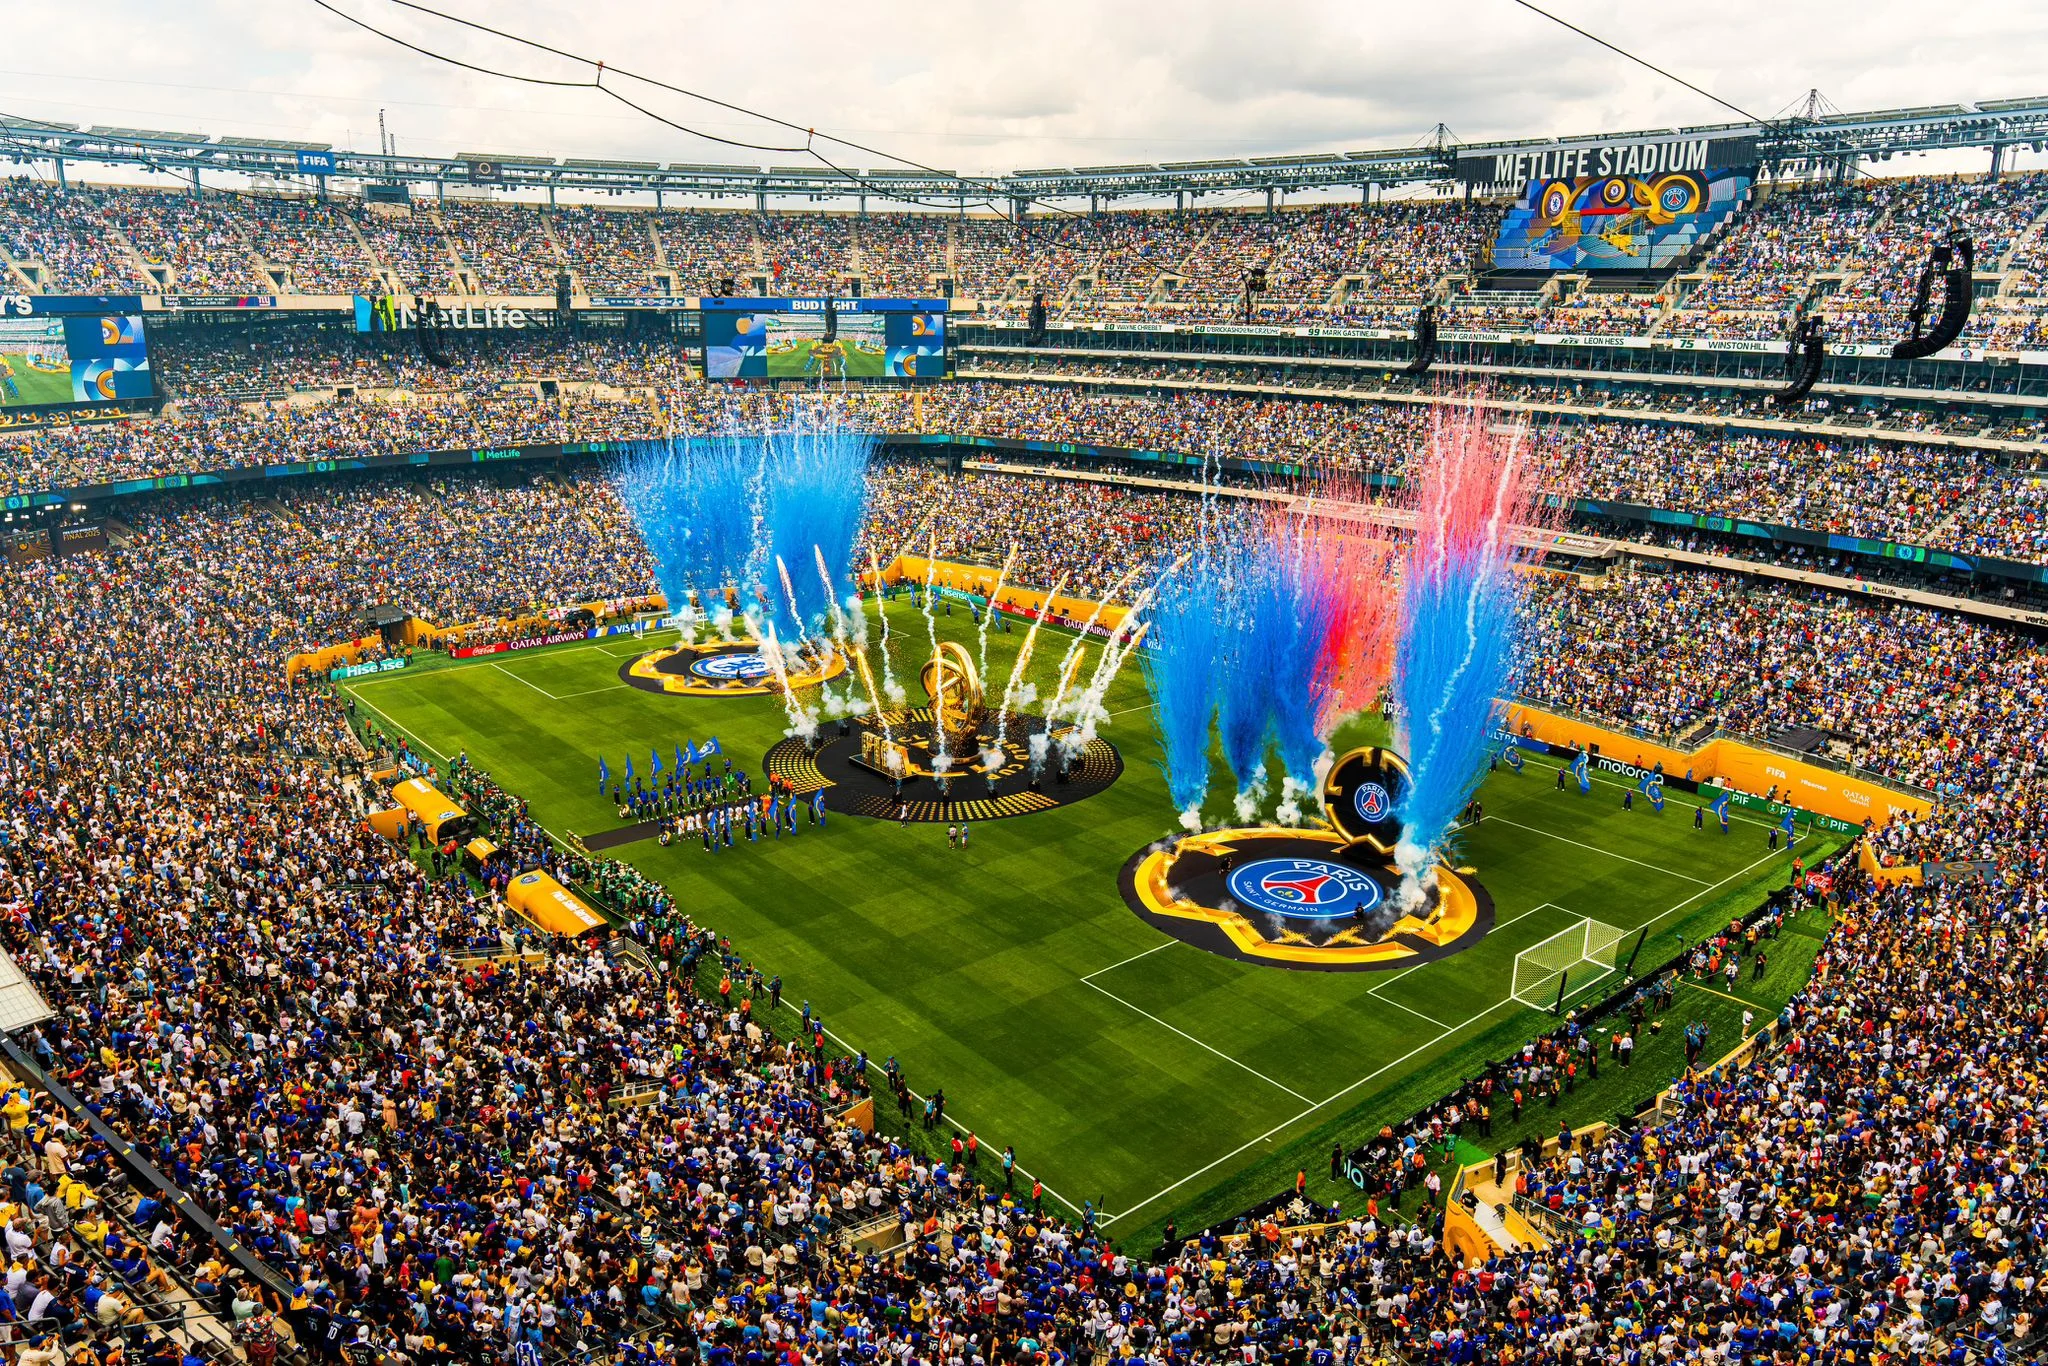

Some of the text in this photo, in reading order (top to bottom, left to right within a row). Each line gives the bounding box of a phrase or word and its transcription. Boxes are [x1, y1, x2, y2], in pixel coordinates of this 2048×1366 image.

[303, 156, 329, 167] FIFA
[1494, 140, 1709, 181] METLIFE STADIUM
[792, 300, 858, 310] BUD LGHT
[1194, 325, 1205, 333] 60
[1308, 328, 1320, 336] 99
[1342, 330, 1379, 338] GASTINEAU
[1438, 332, 1500, 341] ARRY GRANTHAM
[1584, 337, 1603, 345] LEON
[1604, 338, 1624, 346] HESS
[1680, 339, 1768, 351] 75 WINSTON HILL
[1840, 345, 1857, 354] 73
[486, 449, 521, 459] MetLife
[63, 529, 101, 541] FINAL 2025
[1872, 586, 1897, 596] MetLife
[1064, 619, 1085, 631] QATA
[2025, 615, 2048, 626] veriz
[616, 623, 637, 634] VISA
[510, 631, 585, 650] QATAR AIRWAYS
[1147, 638, 1163, 652] VISA
[472, 644, 497, 657] Coca-Cola
[347, 660, 404, 678] Hisense
[1598, 758, 1664, 785] motoroa
[1766, 766, 1786, 779] FIFA
[1361, 785, 1385, 798] PARIS
[1842, 788, 1870, 804] QATAR
[1732, 792, 1749, 805] PIF
[1830, 820, 1849, 832] PIF
[1292, 861, 1370, 892] PARIS
[1263, 898, 1319, 912] GERMAIN
[1121, 1306, 1128, 1316] 8
[327, 1326, 338, 1340] 10
[131, 1354, 141, 1363] 5
[1317, 1355, 1327, 1364] 17
